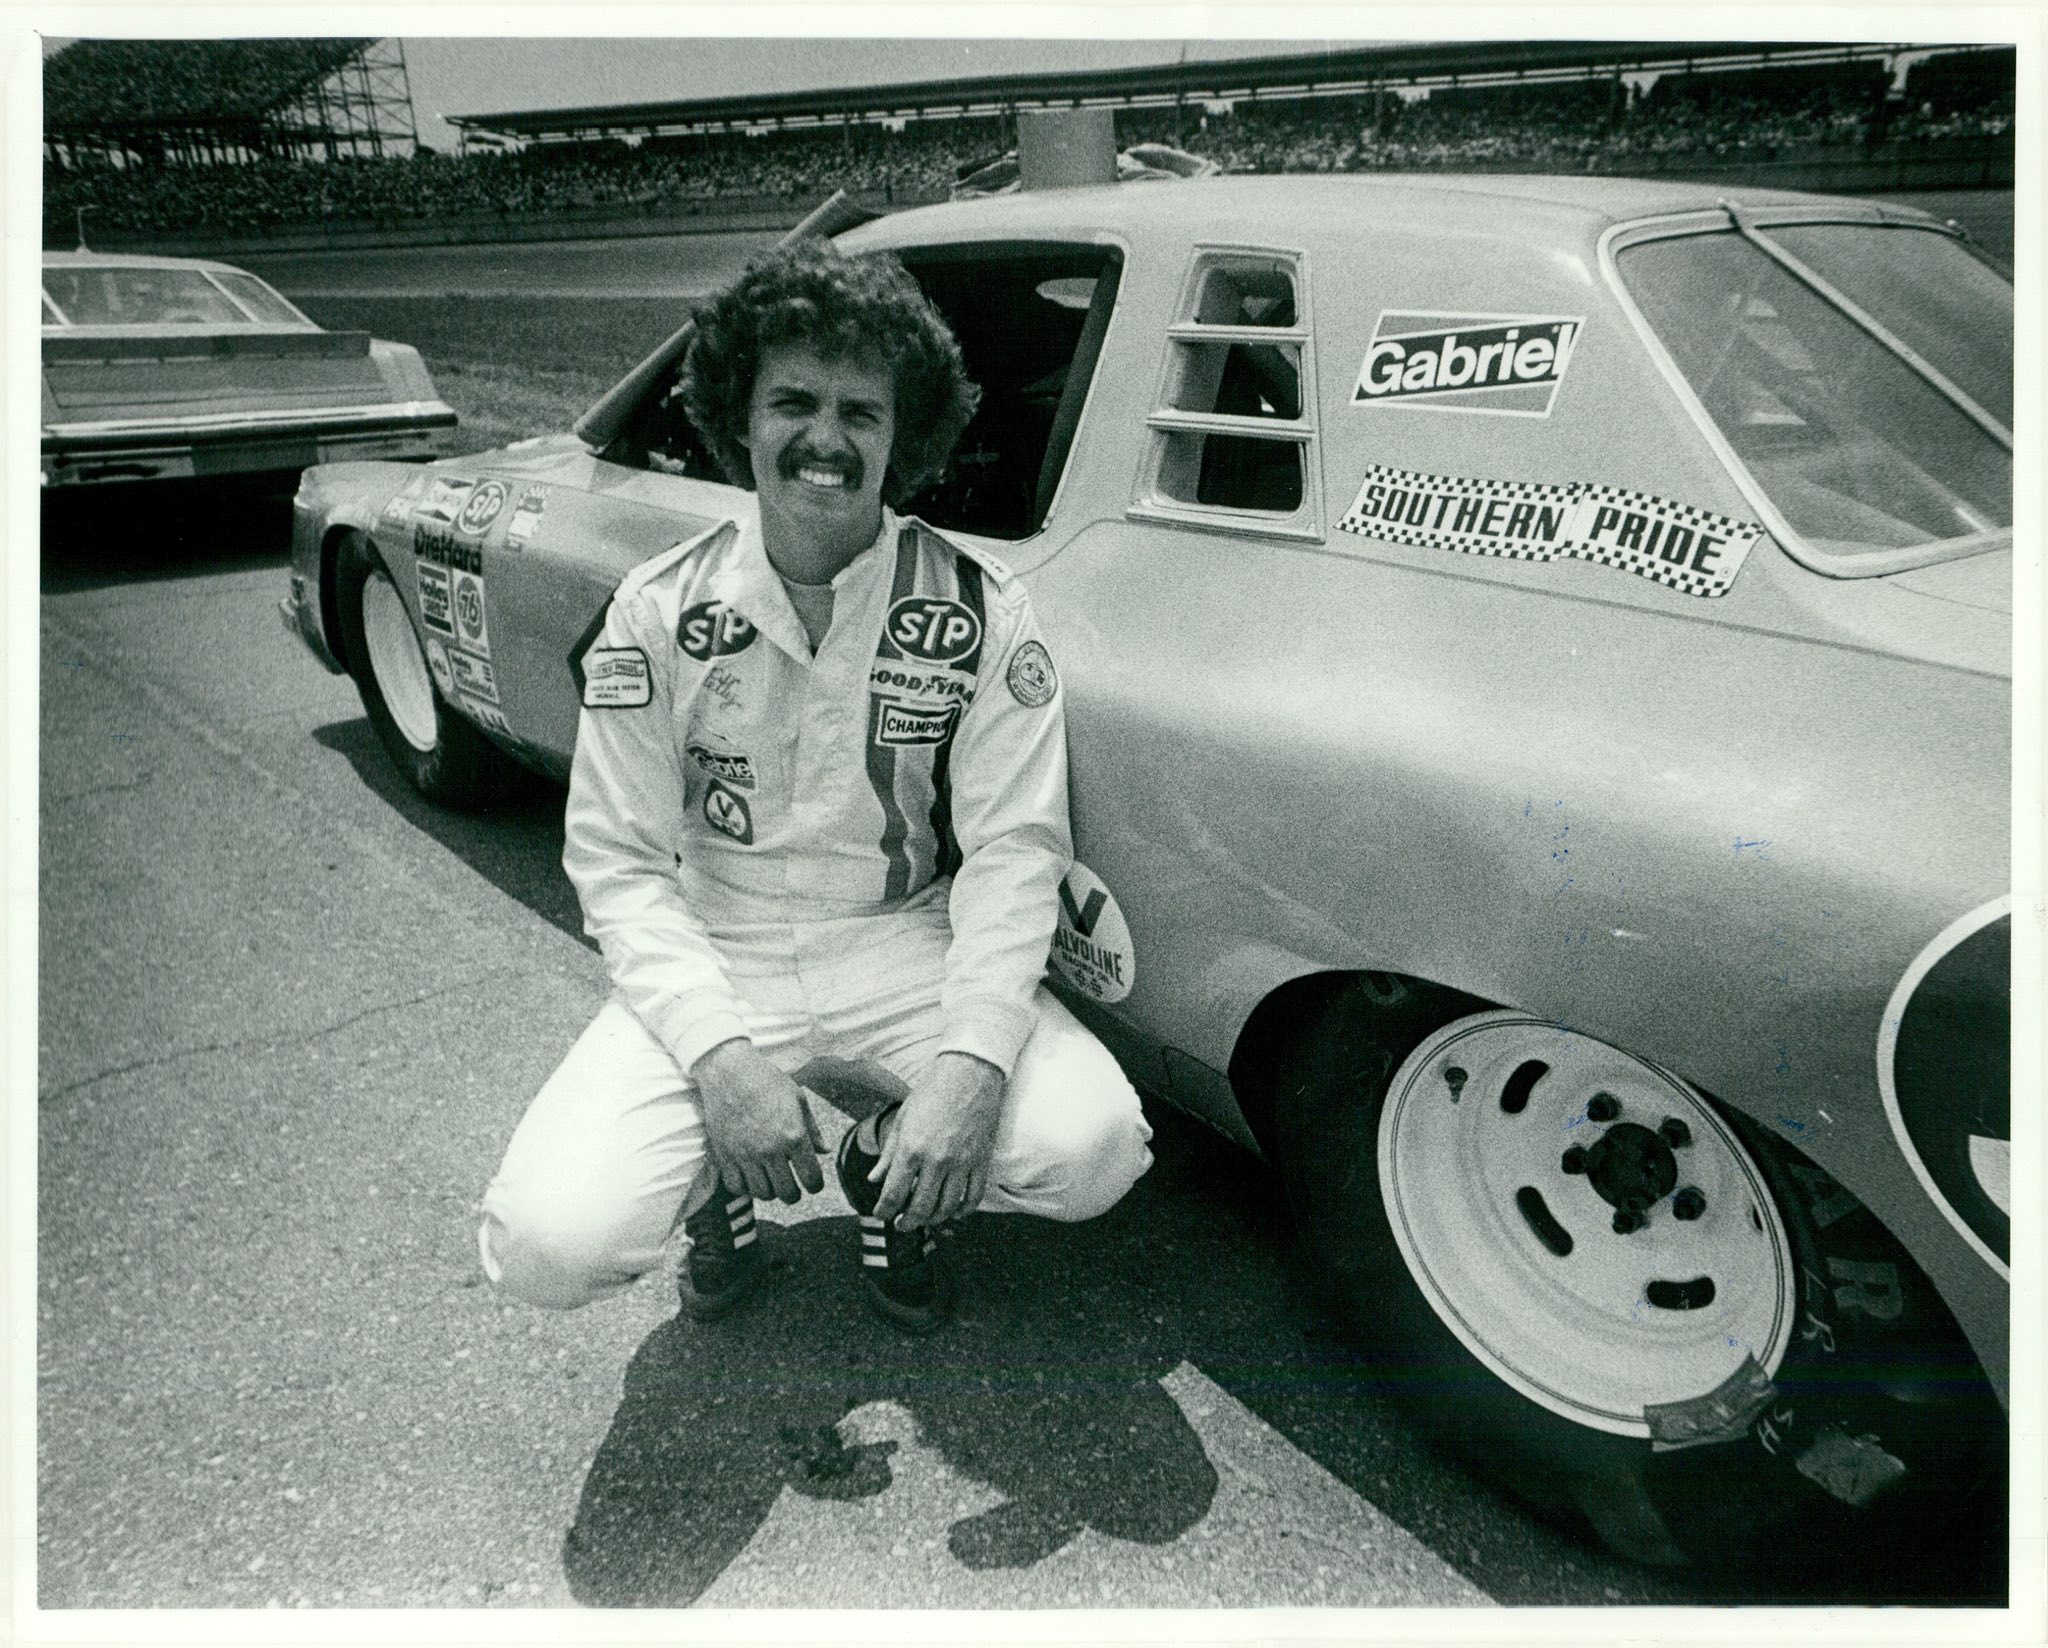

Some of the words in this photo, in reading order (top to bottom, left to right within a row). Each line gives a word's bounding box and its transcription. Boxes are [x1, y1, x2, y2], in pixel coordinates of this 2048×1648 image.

[1360, 324, 1574, 396] Gabriel
[464, 486, 503, 522] STP
[1361, 484, 1566, 543] SOUTHERN
[1589, 506, 1727, 576] PRIDE
[414, 524, 483, 576] DieHard
[458, 592, 481, 627] 76
[683, 603, 750, 656] STP
[895, 603, 970, 651] STP
[886, 716, 948, 734] CHAMPIO
[1057, 874, 1108, 938] V
[1051, 927, 1125, 987] ALVOLINE
